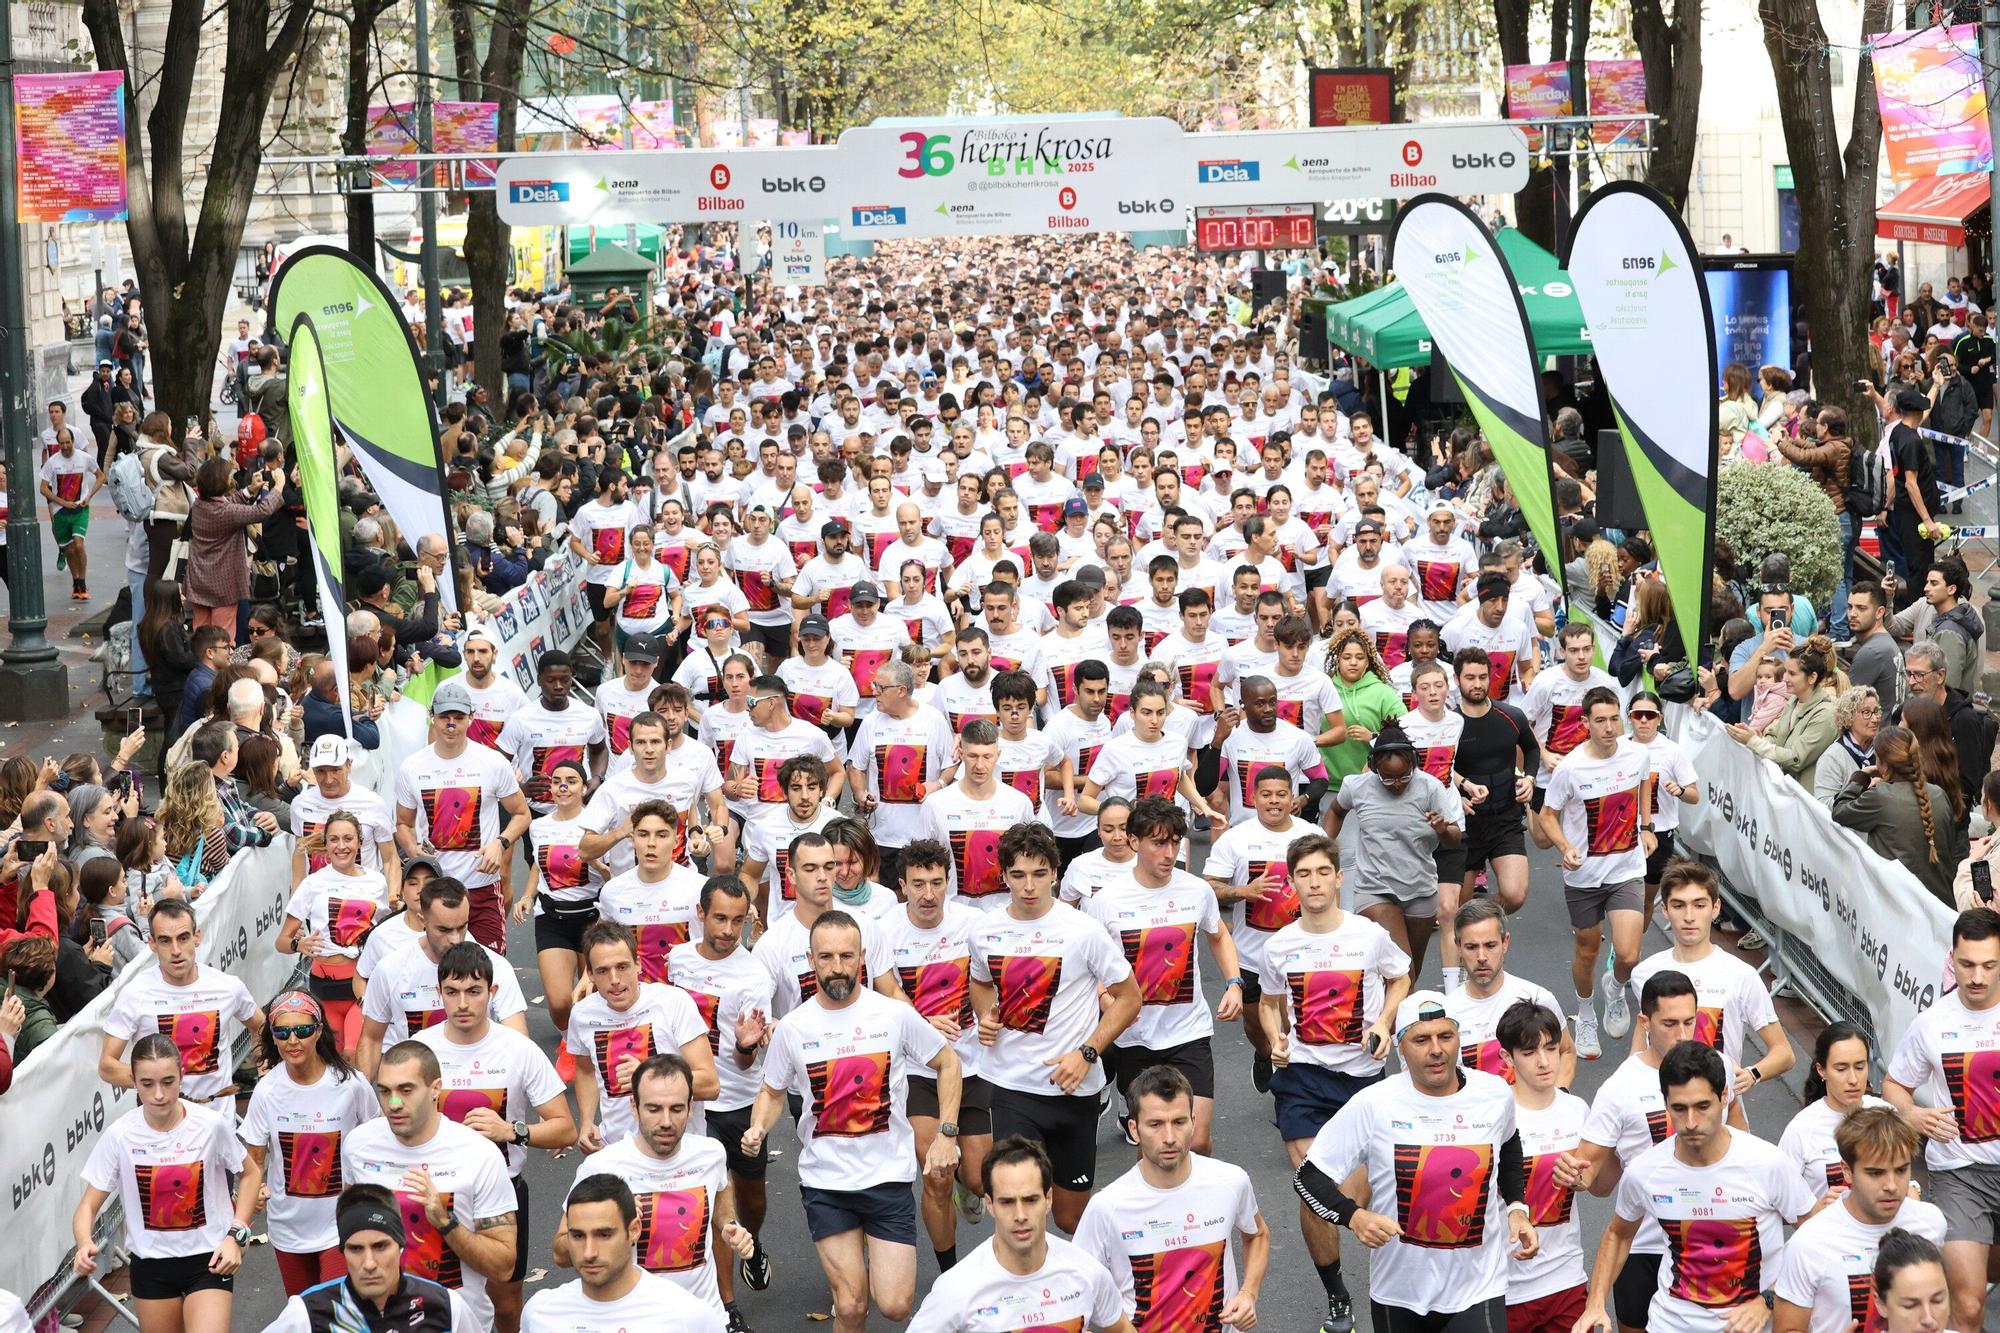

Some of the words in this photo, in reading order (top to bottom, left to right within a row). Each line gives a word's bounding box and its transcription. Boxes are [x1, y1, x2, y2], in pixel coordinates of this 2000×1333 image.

[1509, 80, 1532, 92] Fair
[1510, 90, 1569, 103] Saturday
[974, 128, 1017, 141] Bilboko
[898, 131, 955, 179] 36
[1452, 153, 1496, 169] bbk
[1067, 162, 1095, 173] 2025
[1302, 158, 1329, 167] aena
[1208, 165, 1250, 182] Deia
[1390, 173, 1437, 188] Bilbao
[611, 180, 639, 189] aena
[762, 177, 806, 193] bbk
[518, 186, 561, 203] Deia
[697, 197, 745, 211] Bilbao
[950, 204, 974, 212] aena
[1118, 200, 1157, 214] bbk
[860, 210, 897, 225] Deia
[1048, 216, 1090, 229] Bilbao
[777, 222, 798, 239] 10
[1725, 315, 1737, 325] Lo
[1763, 833, 1784, 865] bbk
[1801, 863, 1822, 898] bbk
[256, 904, 276, 938] bbk
[1860, 925, 1879, 959] bbk
[220, 939, 239, 973] bbk
[1894, 963, 1921, 1005] bbk
[452, 1078, 472, 1086] 5510
[66, 1114, 94, 1154] bbk
[1433, 1133, 1456, 1142] 3739
[12, 1161, 43, 1212] bbk
[1692, 1206, 1715, 1216] 9081
[1164, 1236, 1188, 1247] 0415
[1022, 1314, 1046, 1324] 1053
